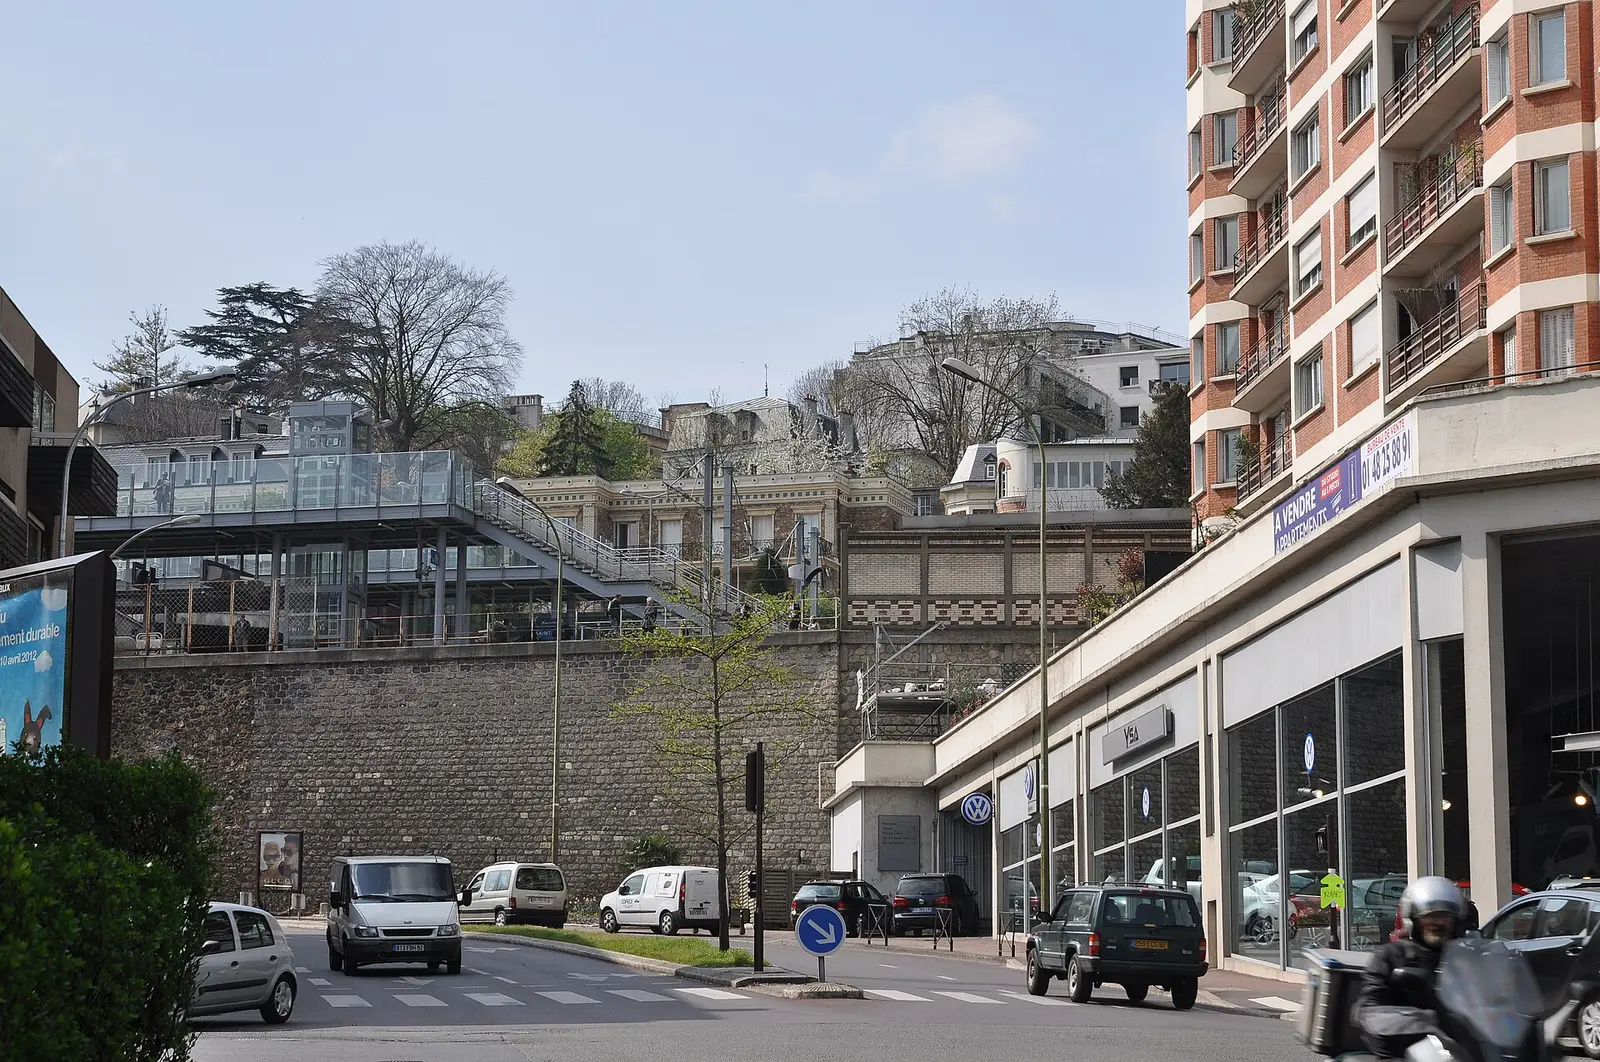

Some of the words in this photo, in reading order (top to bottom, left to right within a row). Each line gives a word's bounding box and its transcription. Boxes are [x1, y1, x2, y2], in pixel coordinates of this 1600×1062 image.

[1366, 433, 1384, 453] BUREAU
[1384, 428, 1390, 440] DE
[1390, 418, 1405, 435] VENTE
[1362, 458, 1370, 490] 01
[1372, 450, 1380, 482] 48
[1382, 443, 1390, 476] 25
[1392, 435, 1401, 469] 88
[1402, 429, 1411, 461] 91
[1282, 486, 1317, 525] VENDRE
[1275, 507, 1328, 554] APPARTEMENTS
[26, 622, 60, 642] durable
[21, 650, 37, 663] 2012
[264, 877, 293, 885] GUCCI
